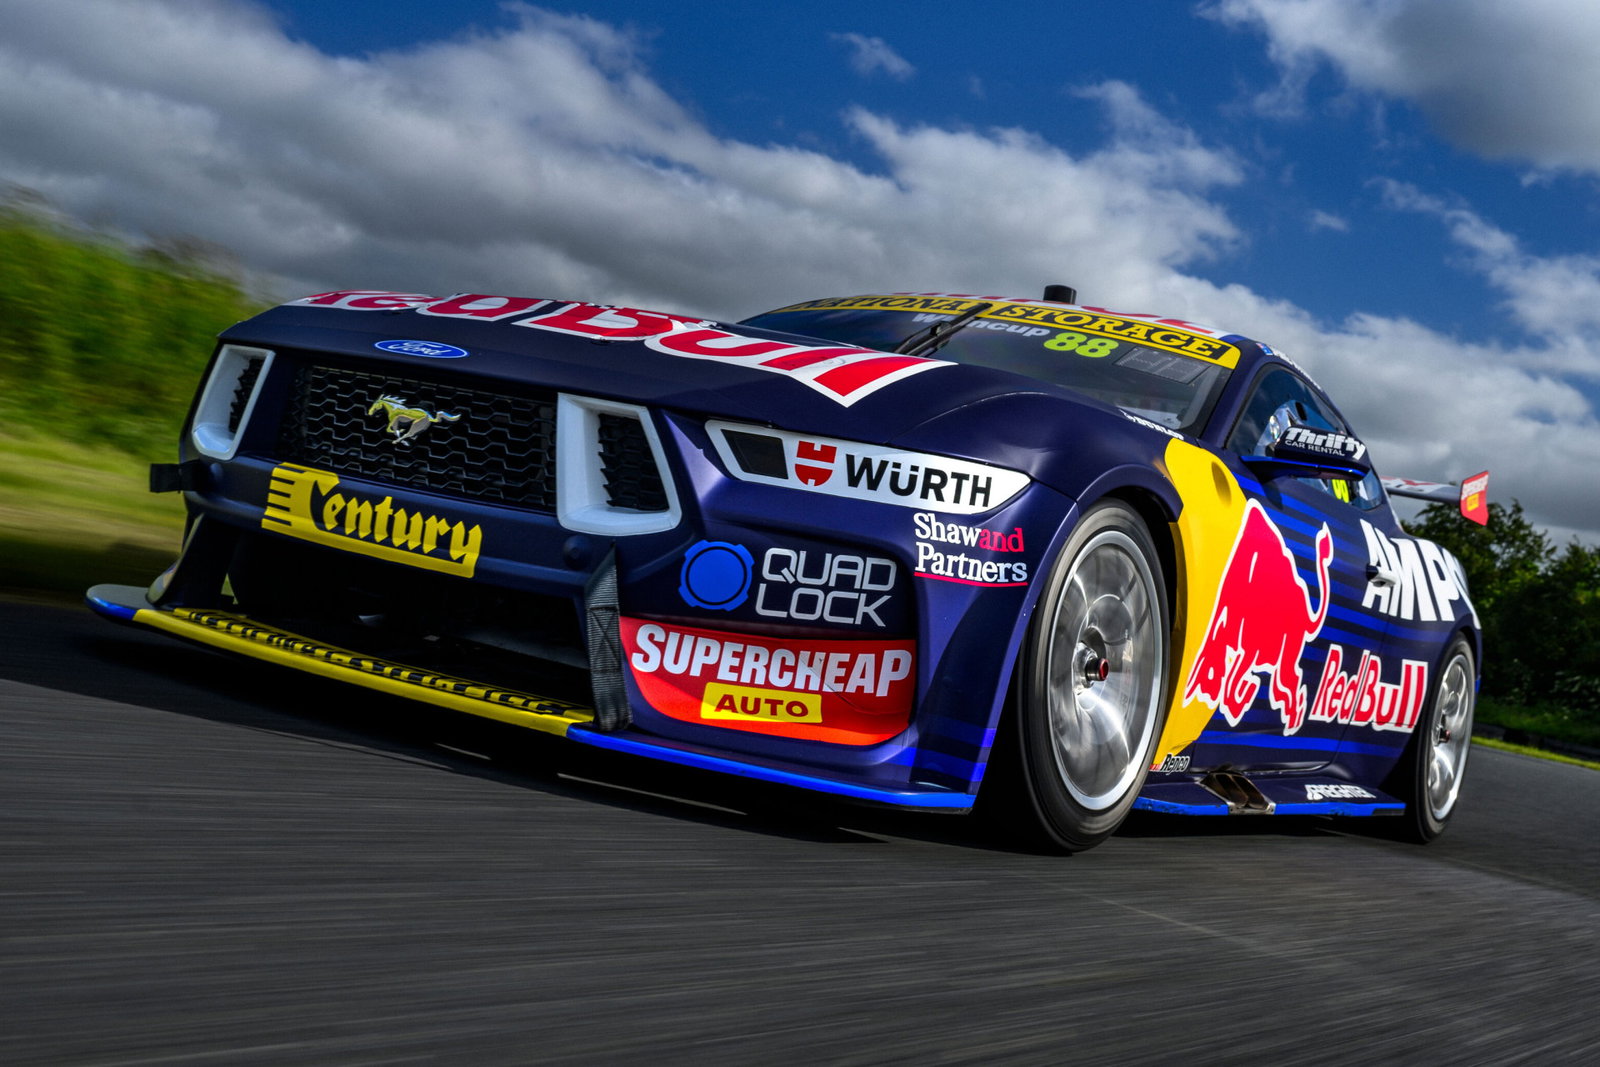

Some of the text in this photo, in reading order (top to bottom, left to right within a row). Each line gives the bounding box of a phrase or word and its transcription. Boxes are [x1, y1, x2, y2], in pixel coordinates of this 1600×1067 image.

[387, 341, 453, 356] Ford
[1000, 306, 1222, 357] STORAGE
[1043, 332, 1119, 358] 88
[1284, 440, 1346, 457] CAR RENTAL
[1285, 427, 1366, 461] Thrifty
[846, 453, 992, 508] WÜRTH
[261, 462, 482, 579] Century
[762, 547, 898, 592] QUAD
[914, 542, 1028, 583] Partners
[756, 583, 892, 627] LOCK
[631, 624, 913, 697] SUPERCHEAP
[714, 693, 809, 718] AUTO
